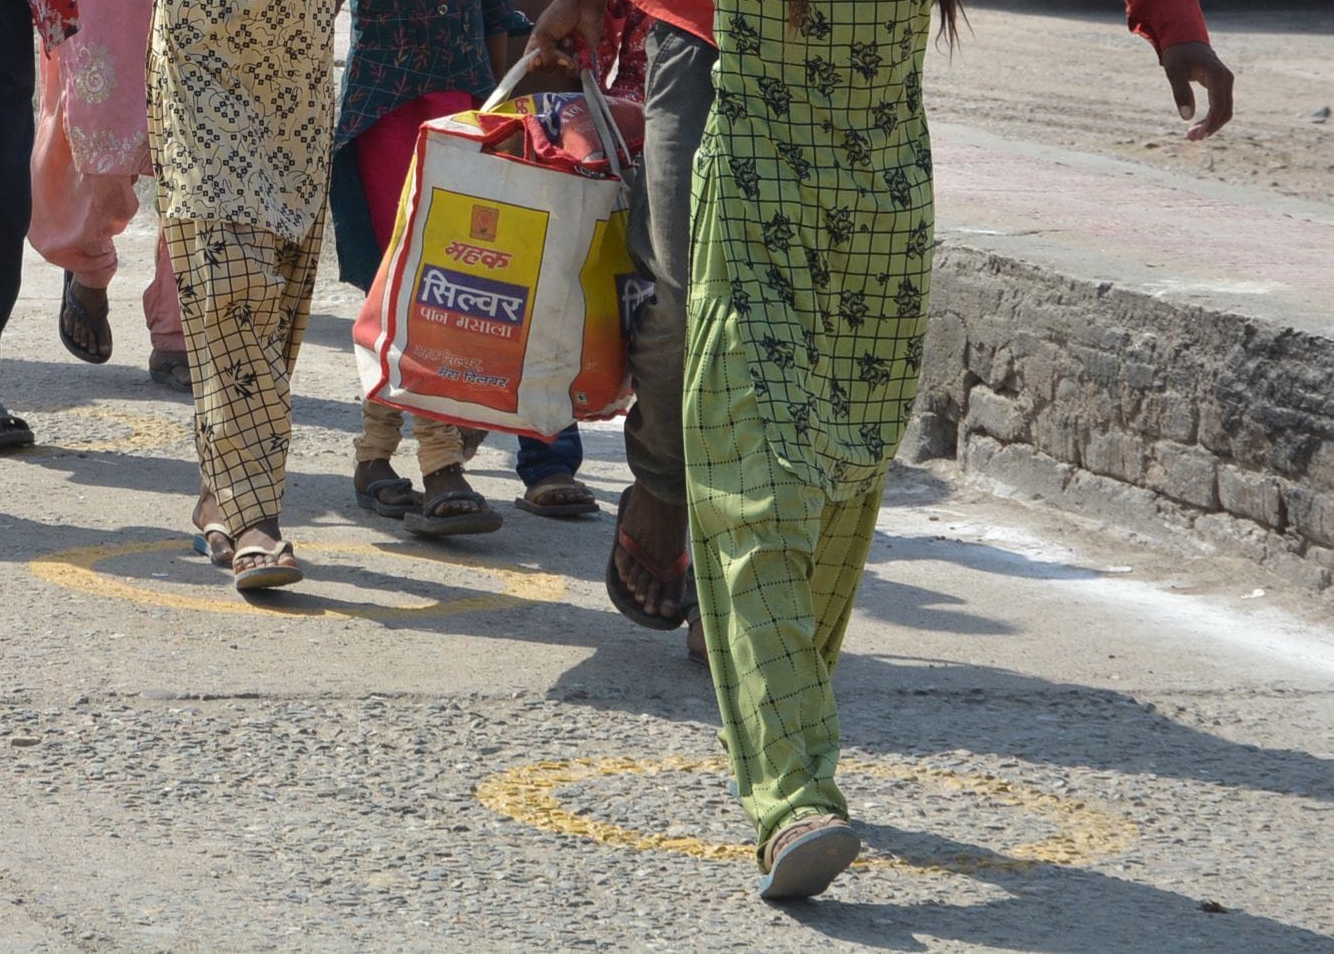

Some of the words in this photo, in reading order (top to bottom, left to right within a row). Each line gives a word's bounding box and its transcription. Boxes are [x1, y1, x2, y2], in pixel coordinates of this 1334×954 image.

[445, 241, 514, 270] महक
[422, 269, 523, 322] सिल्वर
[420, 306, 448, 325] पान
[456, 315, 512, 339] मसाला
